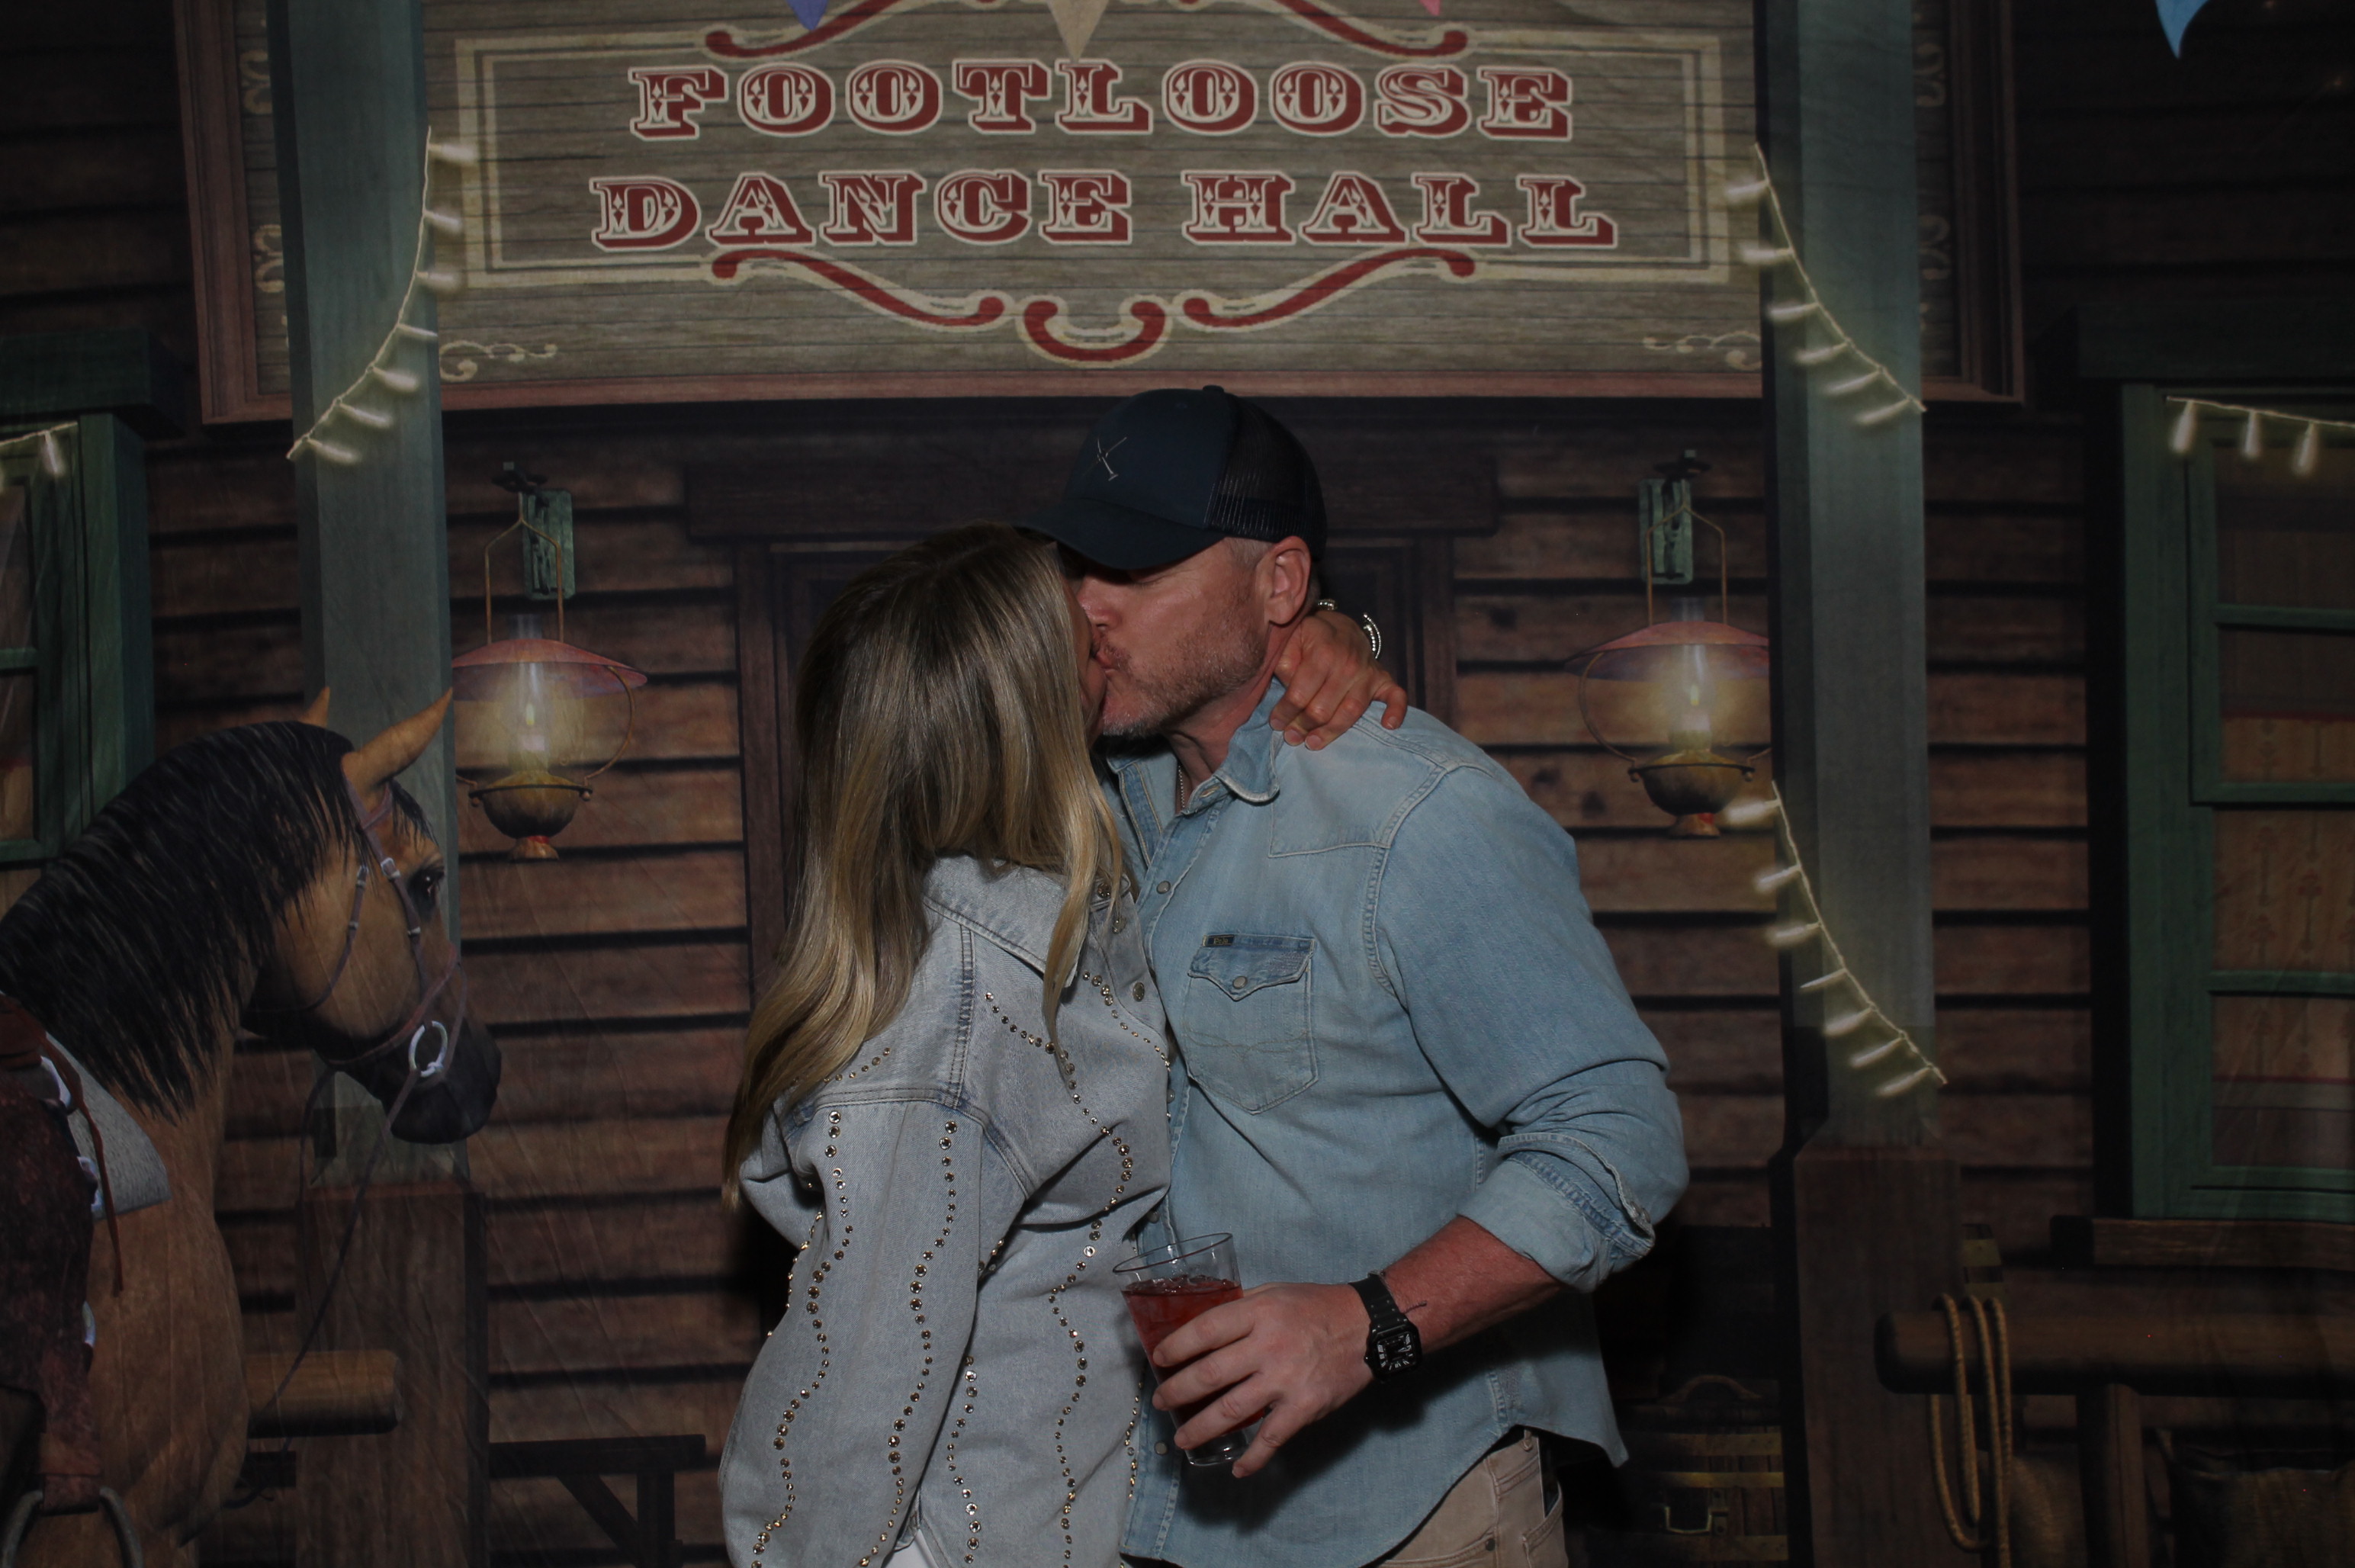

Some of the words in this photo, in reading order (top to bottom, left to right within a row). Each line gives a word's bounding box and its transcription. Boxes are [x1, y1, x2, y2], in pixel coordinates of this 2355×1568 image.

[628, 59, 1573, 140] FOOTLOOSE
[590, 170, 1132, 250] DANCE
[1181, 172, 1618, 248] HALL
